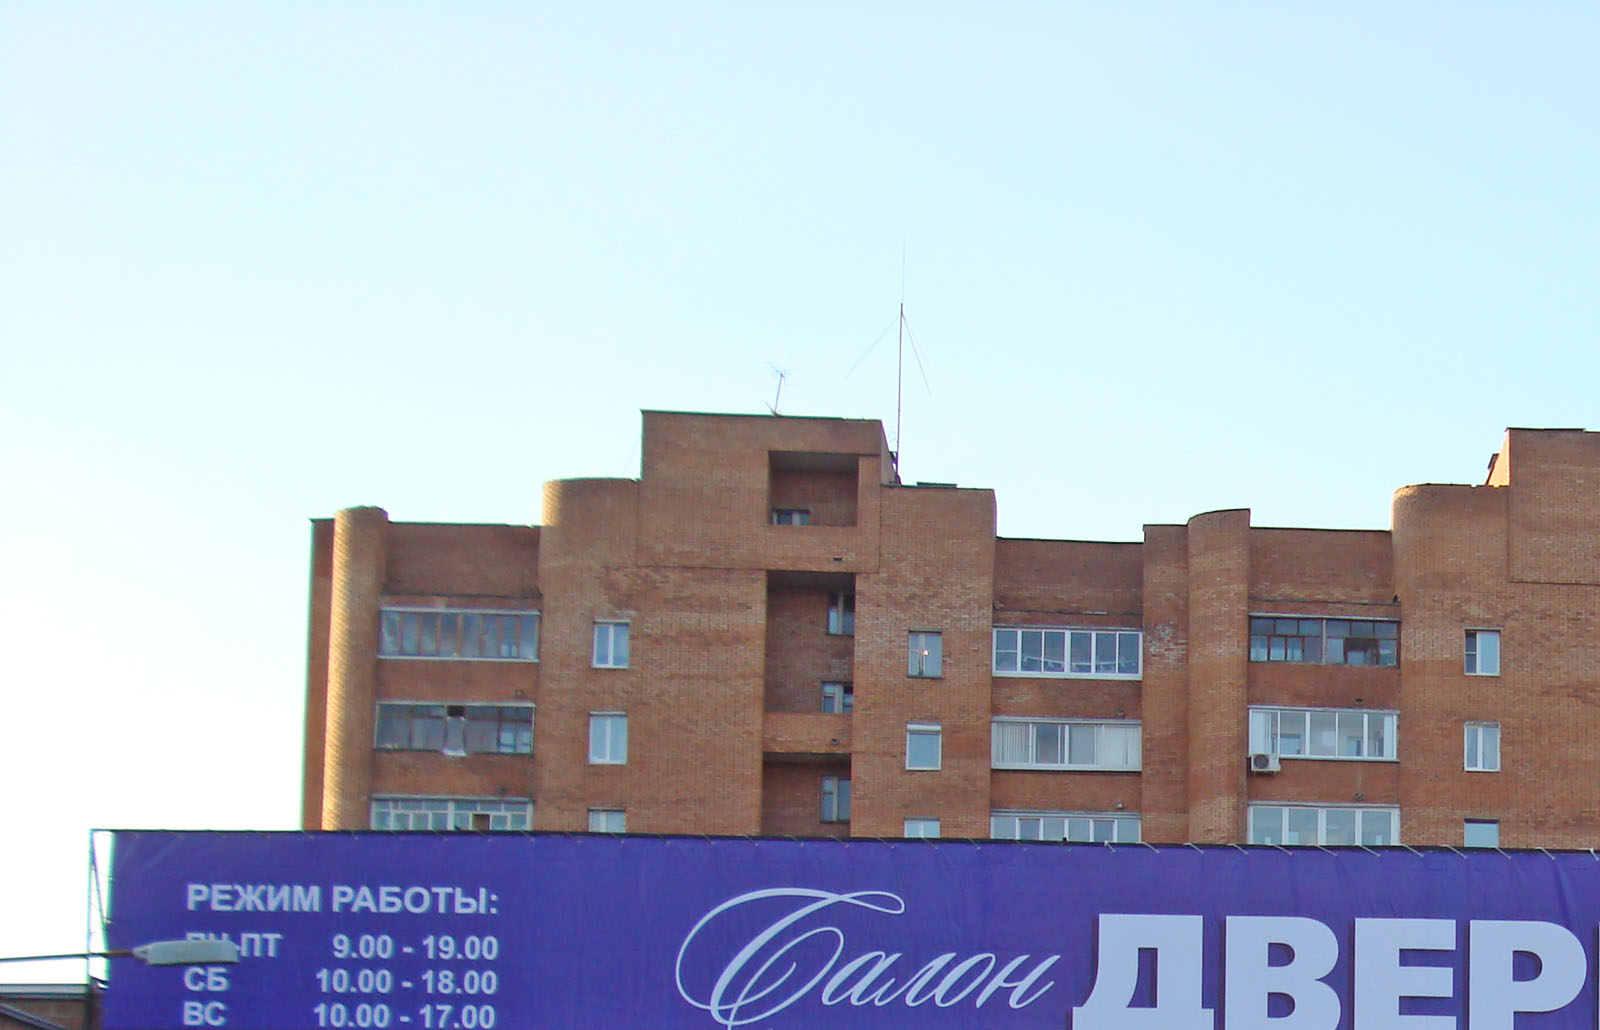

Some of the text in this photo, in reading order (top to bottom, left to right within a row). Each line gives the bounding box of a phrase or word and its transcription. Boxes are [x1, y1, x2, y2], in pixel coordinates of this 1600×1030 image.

[188, 884, 497, 914] РЕЖИМ РАБОТЫ:
[333, 934, 393, 959] 9.00
[423, 936, 498, 960] 19.00
[185, 967, 229, 991] СБ
[317, 968, 393, 993] 10.00
[422, 970, 498, 994] 18.00
[184, 1001, 226, 1026] ВС
[314, 1003, 391, 1028] 10.00
[420, 1004, 495, 1029] 17.00
